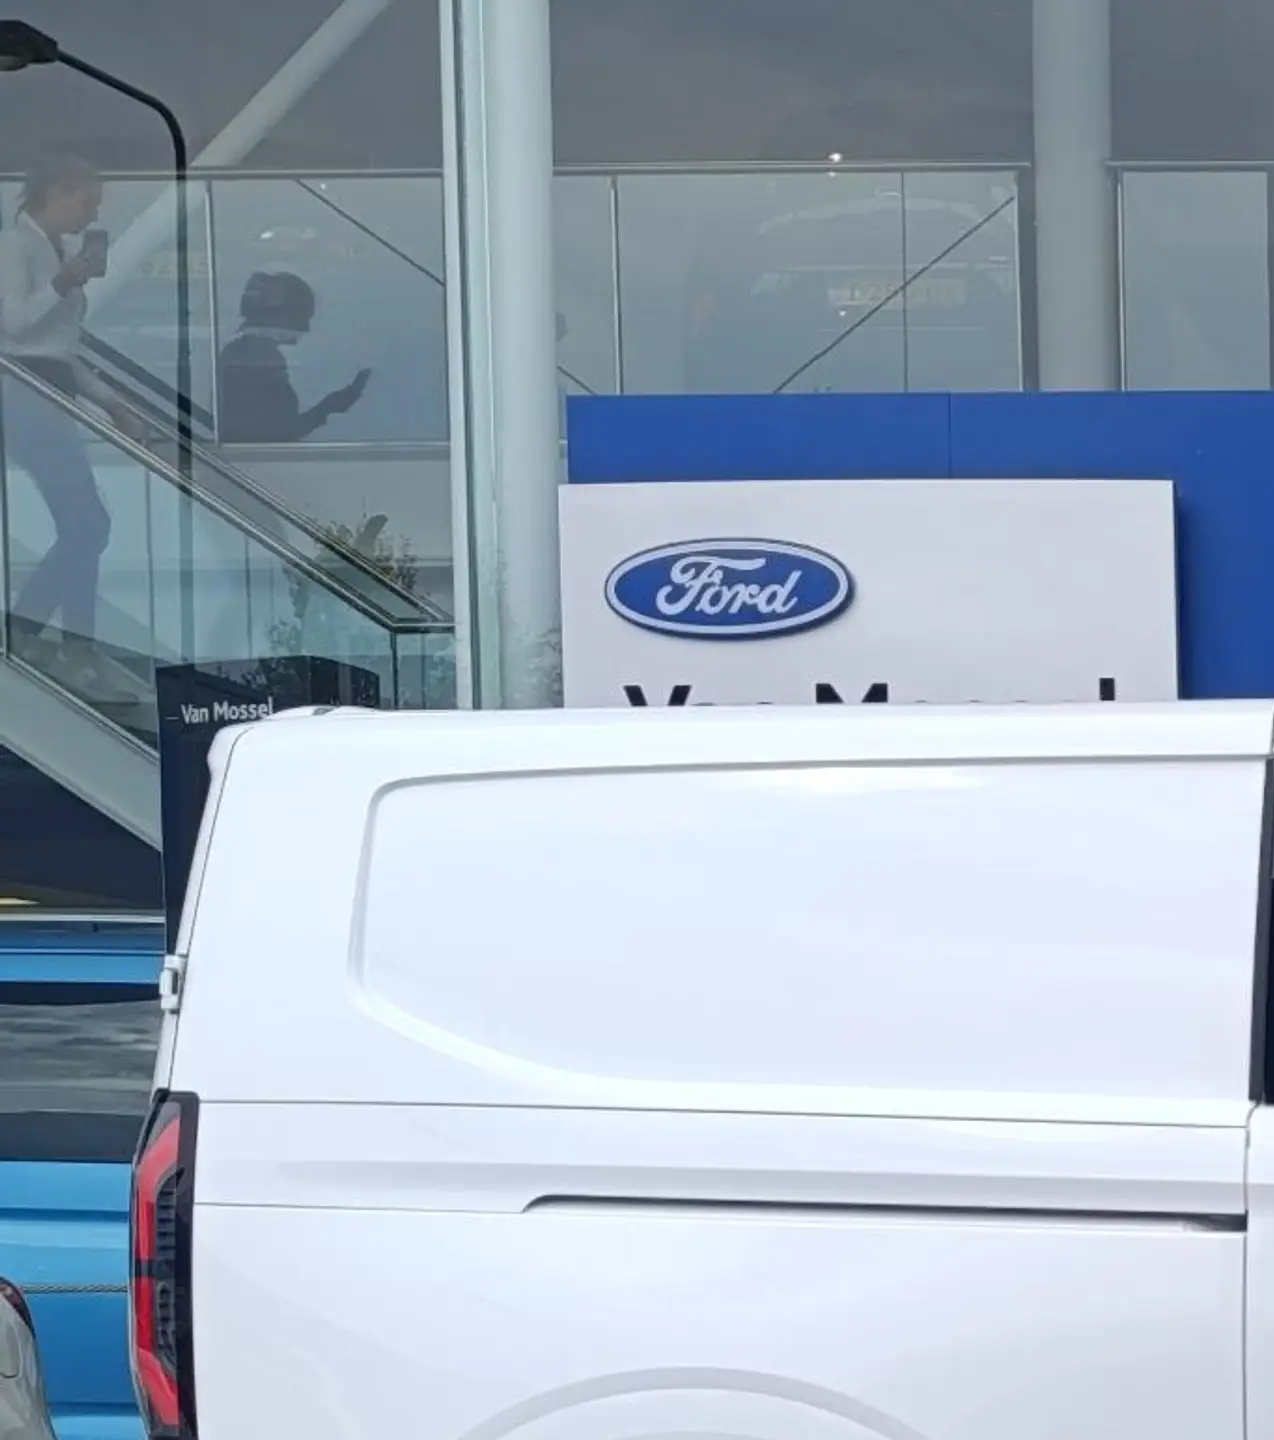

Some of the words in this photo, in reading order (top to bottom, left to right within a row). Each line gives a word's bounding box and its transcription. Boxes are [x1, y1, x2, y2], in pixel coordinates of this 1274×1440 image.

[655, 554, 803, 615] Ford
[180, 703, 209, 725] Van
[212, 696, 274, 722] Mossel
